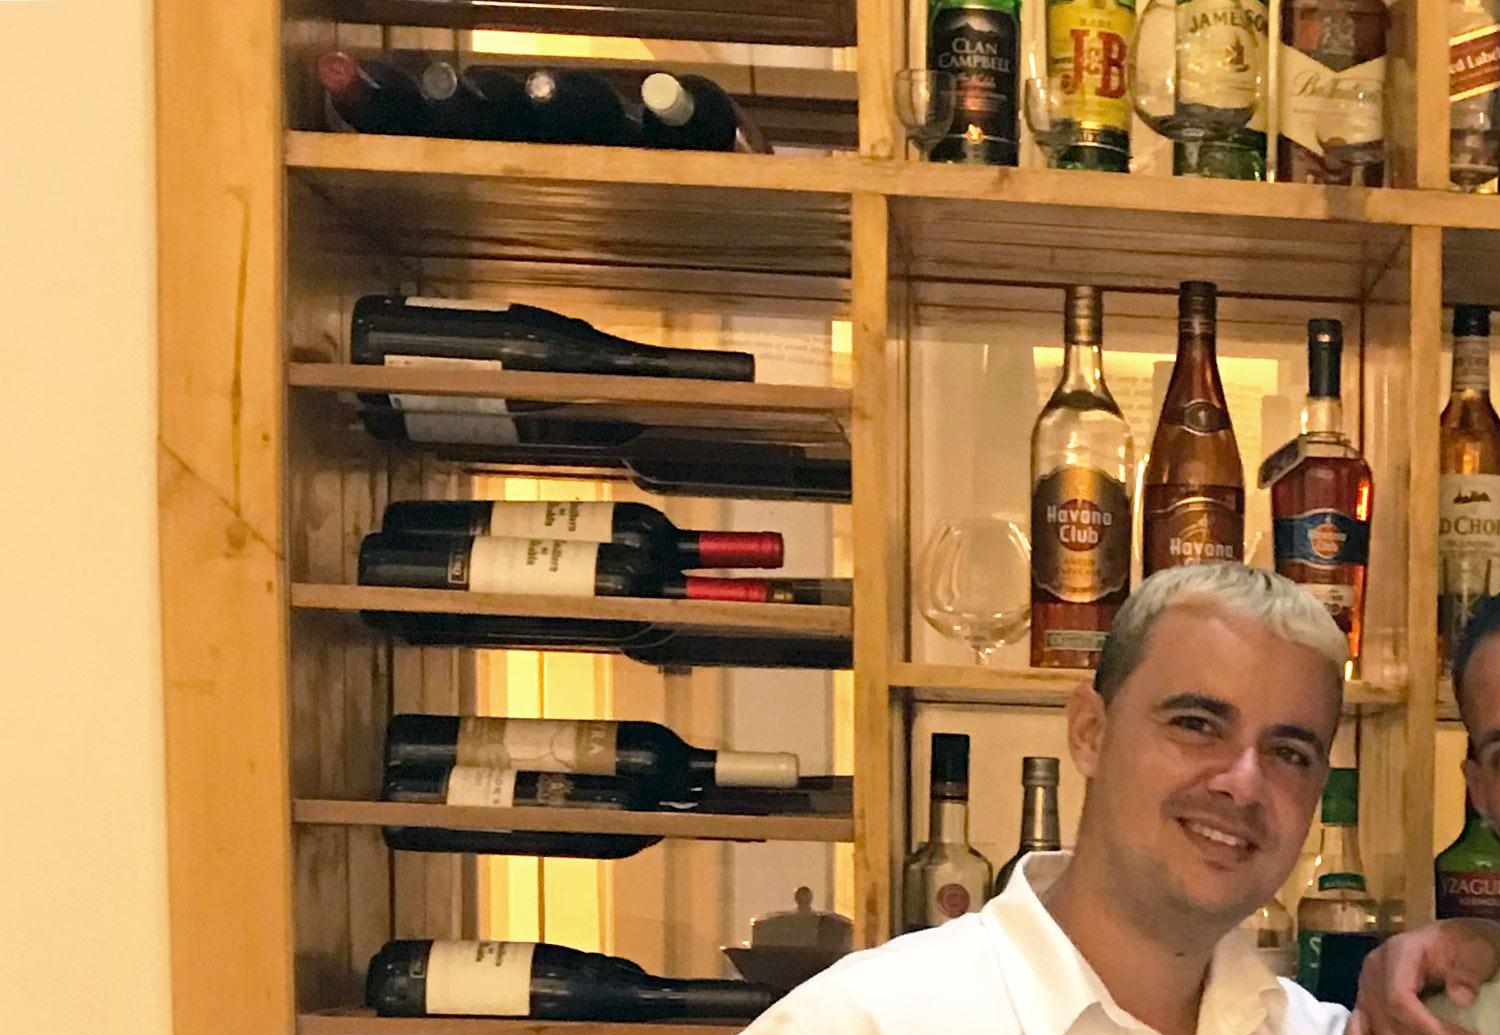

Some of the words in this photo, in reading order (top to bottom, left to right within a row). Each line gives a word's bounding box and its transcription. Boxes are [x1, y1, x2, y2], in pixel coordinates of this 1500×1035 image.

[1190, 9, 1265, 33] JAMESO
[952, 37, 998, 55] CLAN
[1047, 504, 1112, 526] Havana
[1059, 525, 1099, 544] Club
[1169, 537, 1234, 558] Havana
